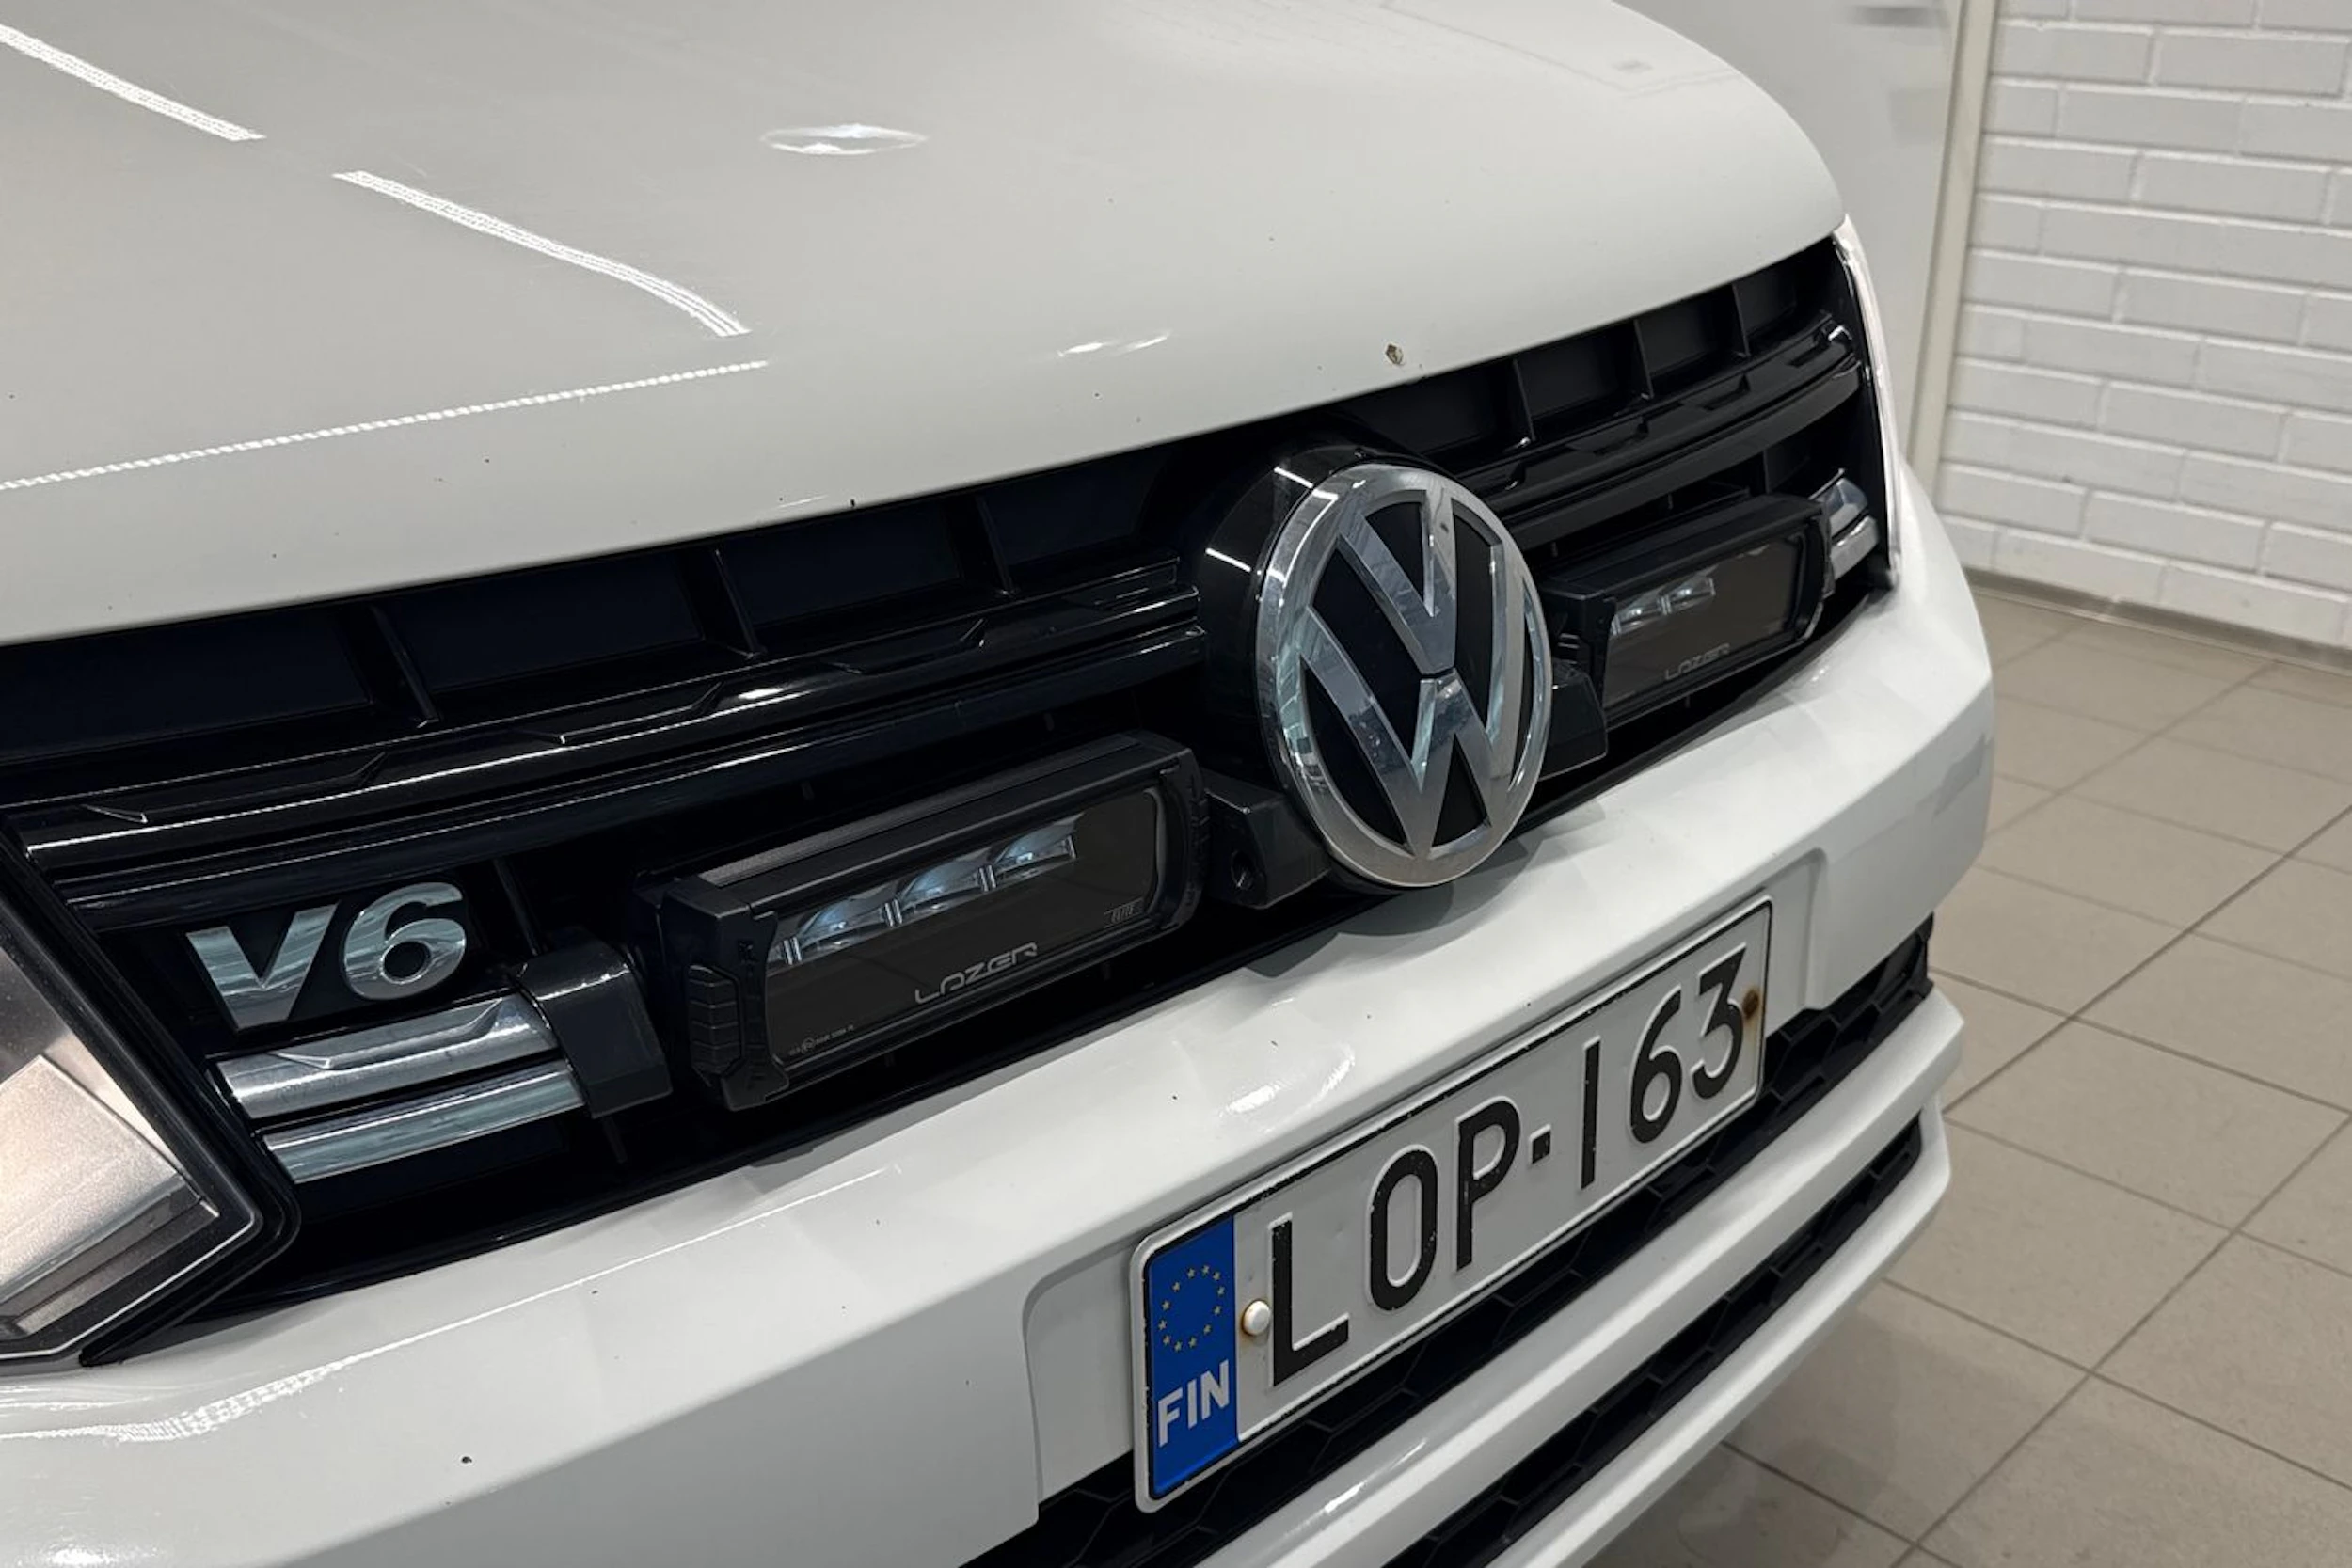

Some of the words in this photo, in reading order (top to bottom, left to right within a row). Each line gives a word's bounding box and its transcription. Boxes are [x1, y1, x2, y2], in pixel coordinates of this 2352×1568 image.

[1270, 475, 1537, 872] VW
[1664, 642, 1730, 680] LAZER
[185, 881, 466, 1029] V6
[914, 942, 1038, 1004] LAZER
[1268, 943, 1747, 1387] LOP-163
[1156, 1359, 1231, 1448] FIN
